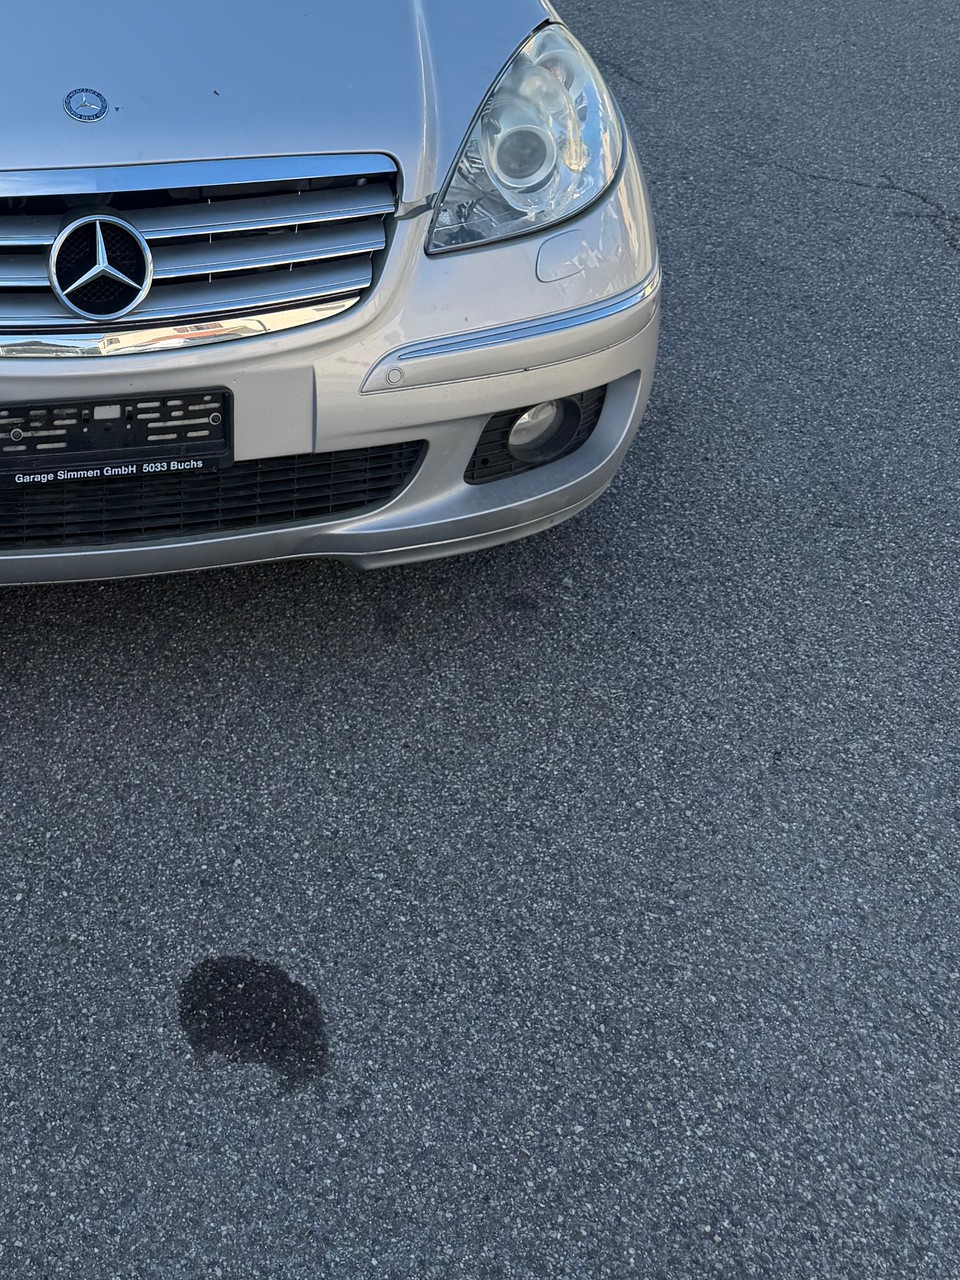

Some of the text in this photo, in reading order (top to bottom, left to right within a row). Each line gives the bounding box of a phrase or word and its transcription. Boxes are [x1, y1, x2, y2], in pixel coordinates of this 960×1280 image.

[14, 459, 203, 483] Garage Simmen GmbH 5033 Buchs
